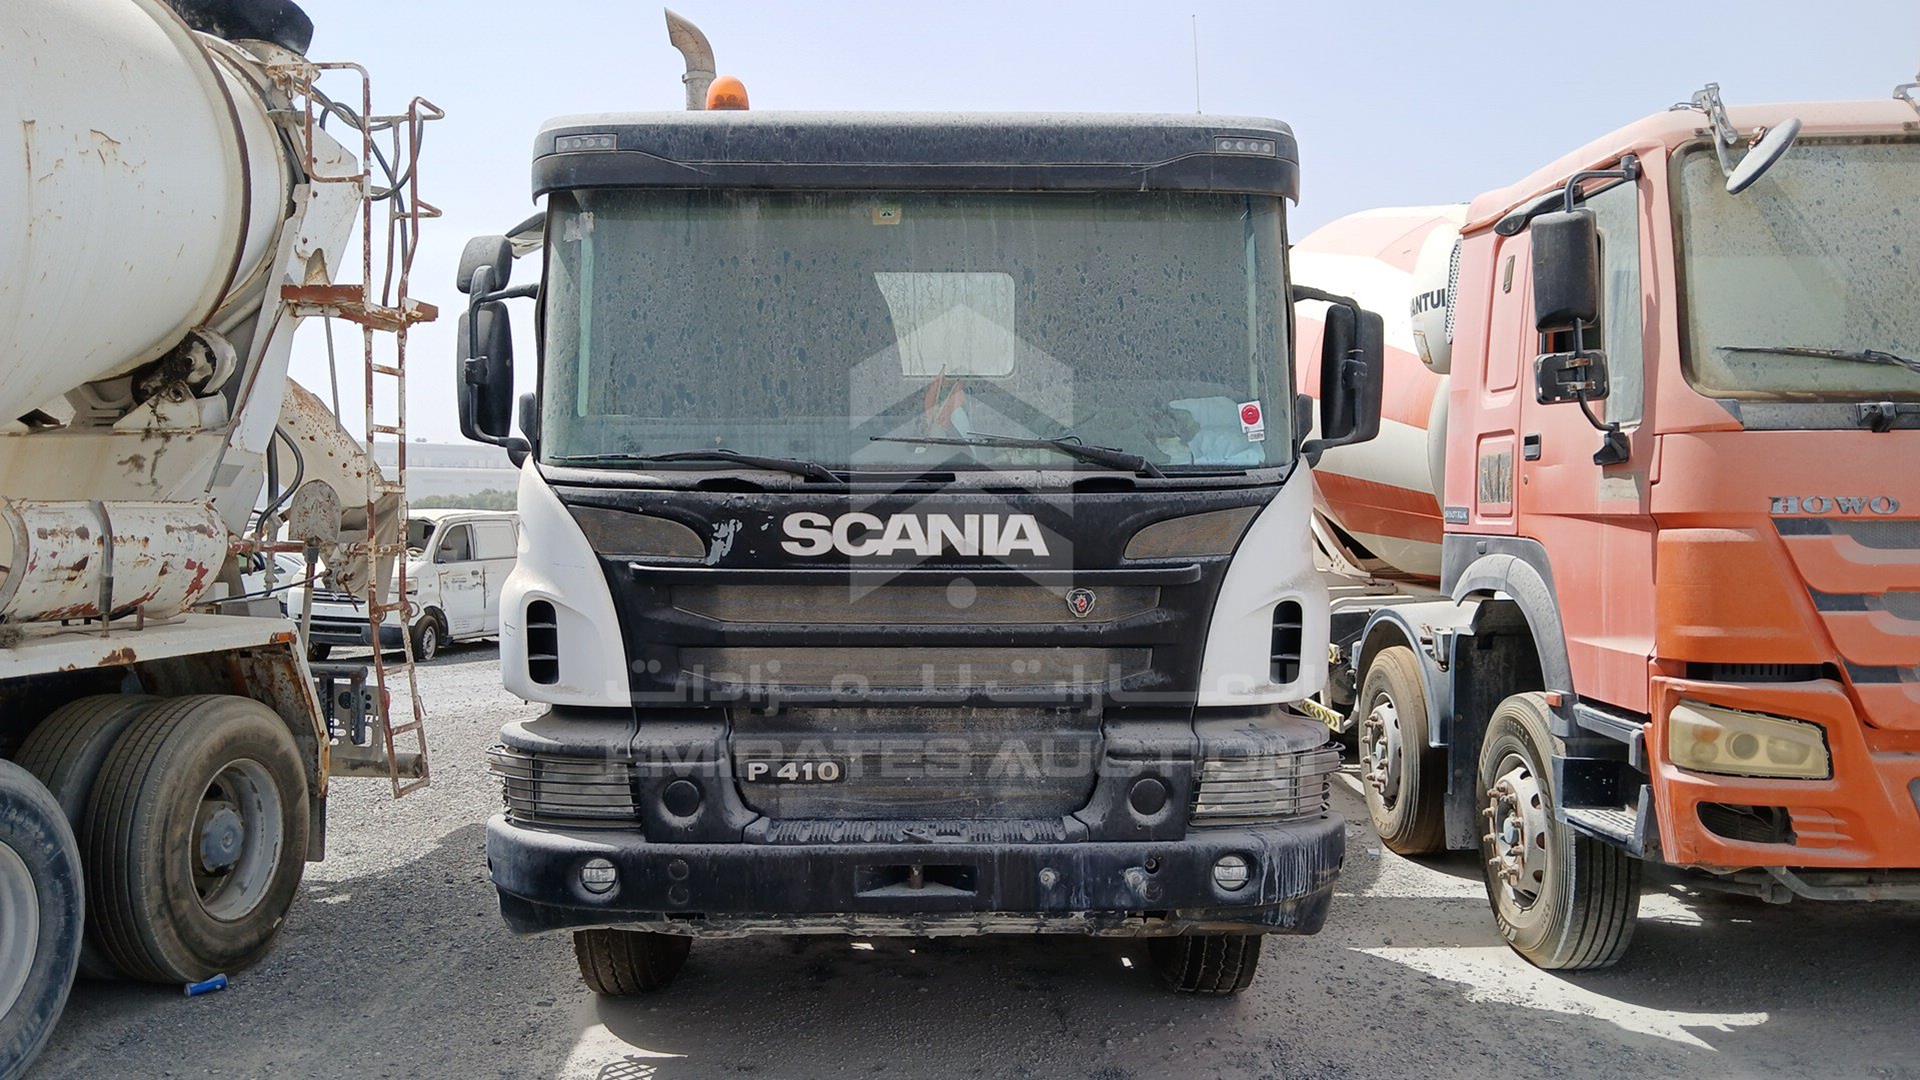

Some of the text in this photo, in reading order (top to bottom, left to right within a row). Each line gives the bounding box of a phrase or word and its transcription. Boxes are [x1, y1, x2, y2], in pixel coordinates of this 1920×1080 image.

[1768, 496, 1901, 515] HOWO
[780, 511, 1051, 557] SCANIA
[747, 762, 840, 781] P 410
